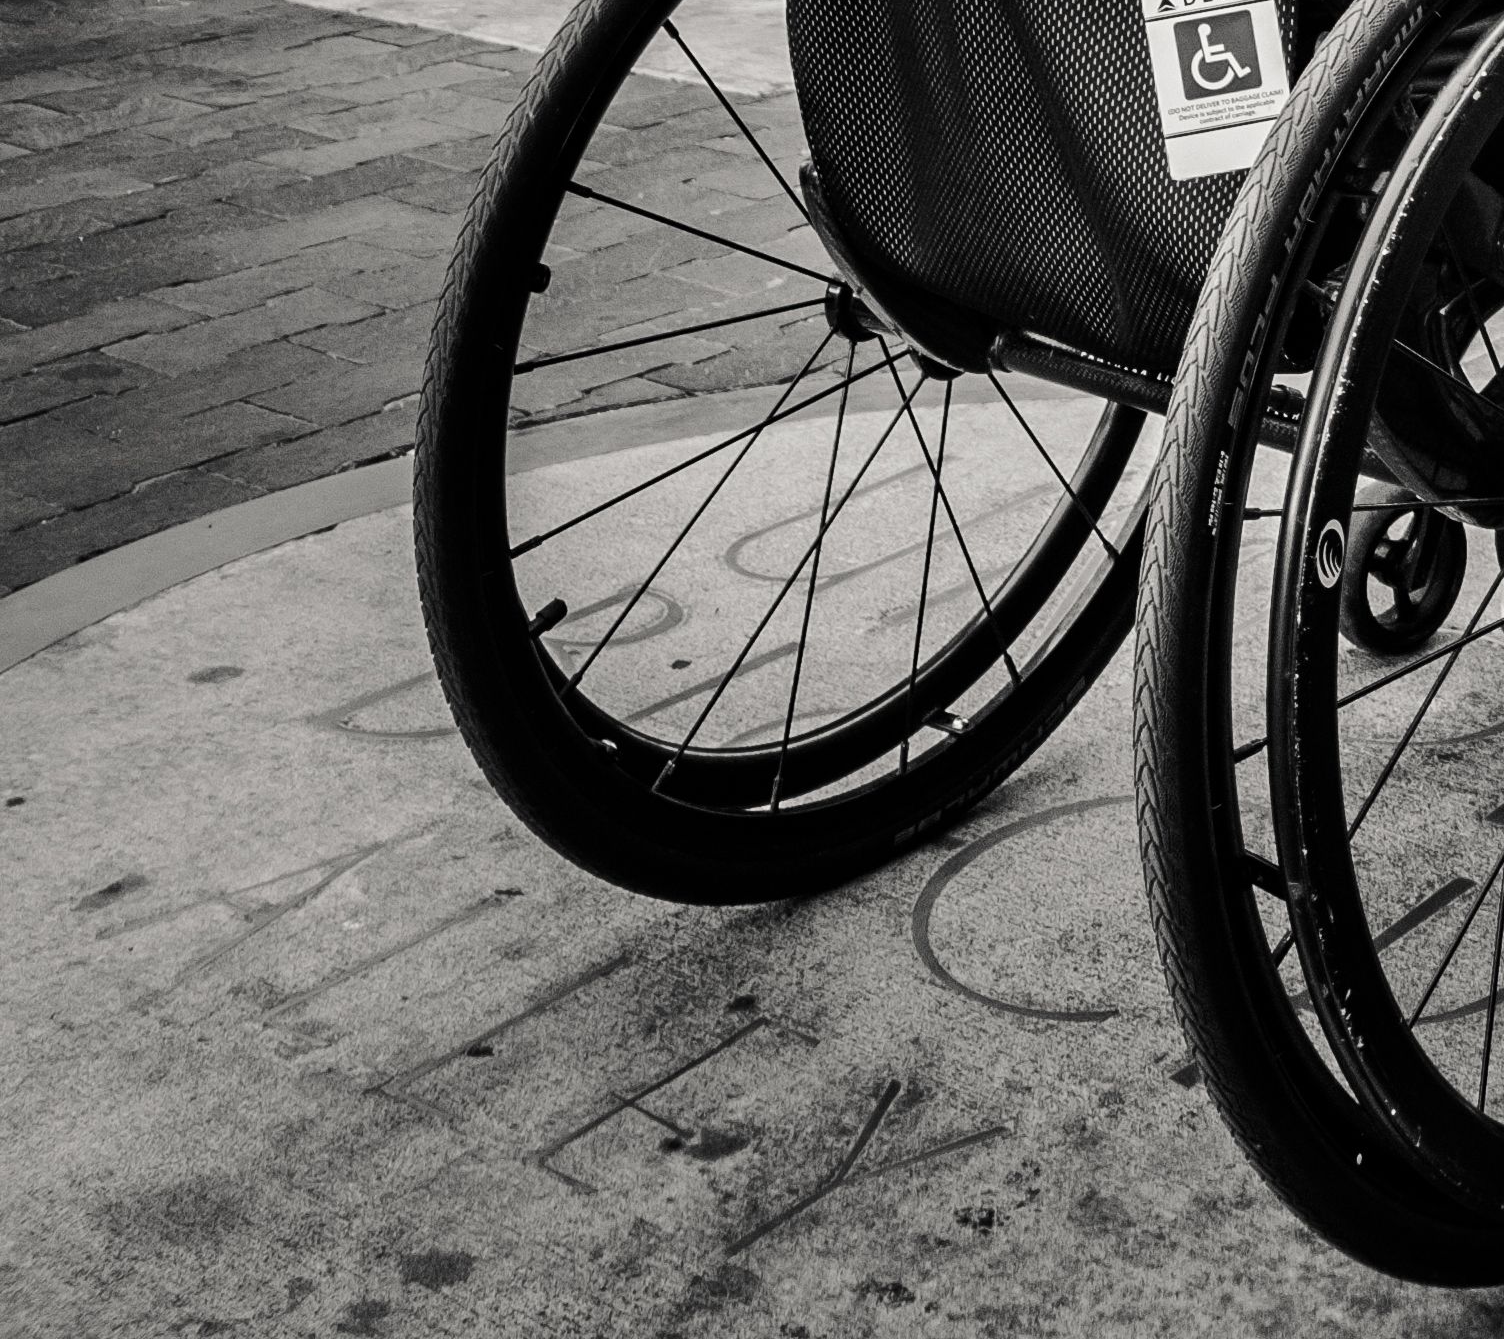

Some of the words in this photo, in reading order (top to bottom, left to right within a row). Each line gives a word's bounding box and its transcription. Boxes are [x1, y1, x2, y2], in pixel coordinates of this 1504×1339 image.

[1179, 112, 1199, 121] Device
[1206, 107, 1227, 116] subject
[1246, 98, 1275, 109] applicable
[1196, 100, 1220, 110] DELIVER
[1231, 93, 1260, 103] BAGGAGE
[1199, 115, 1223, 124] contract
